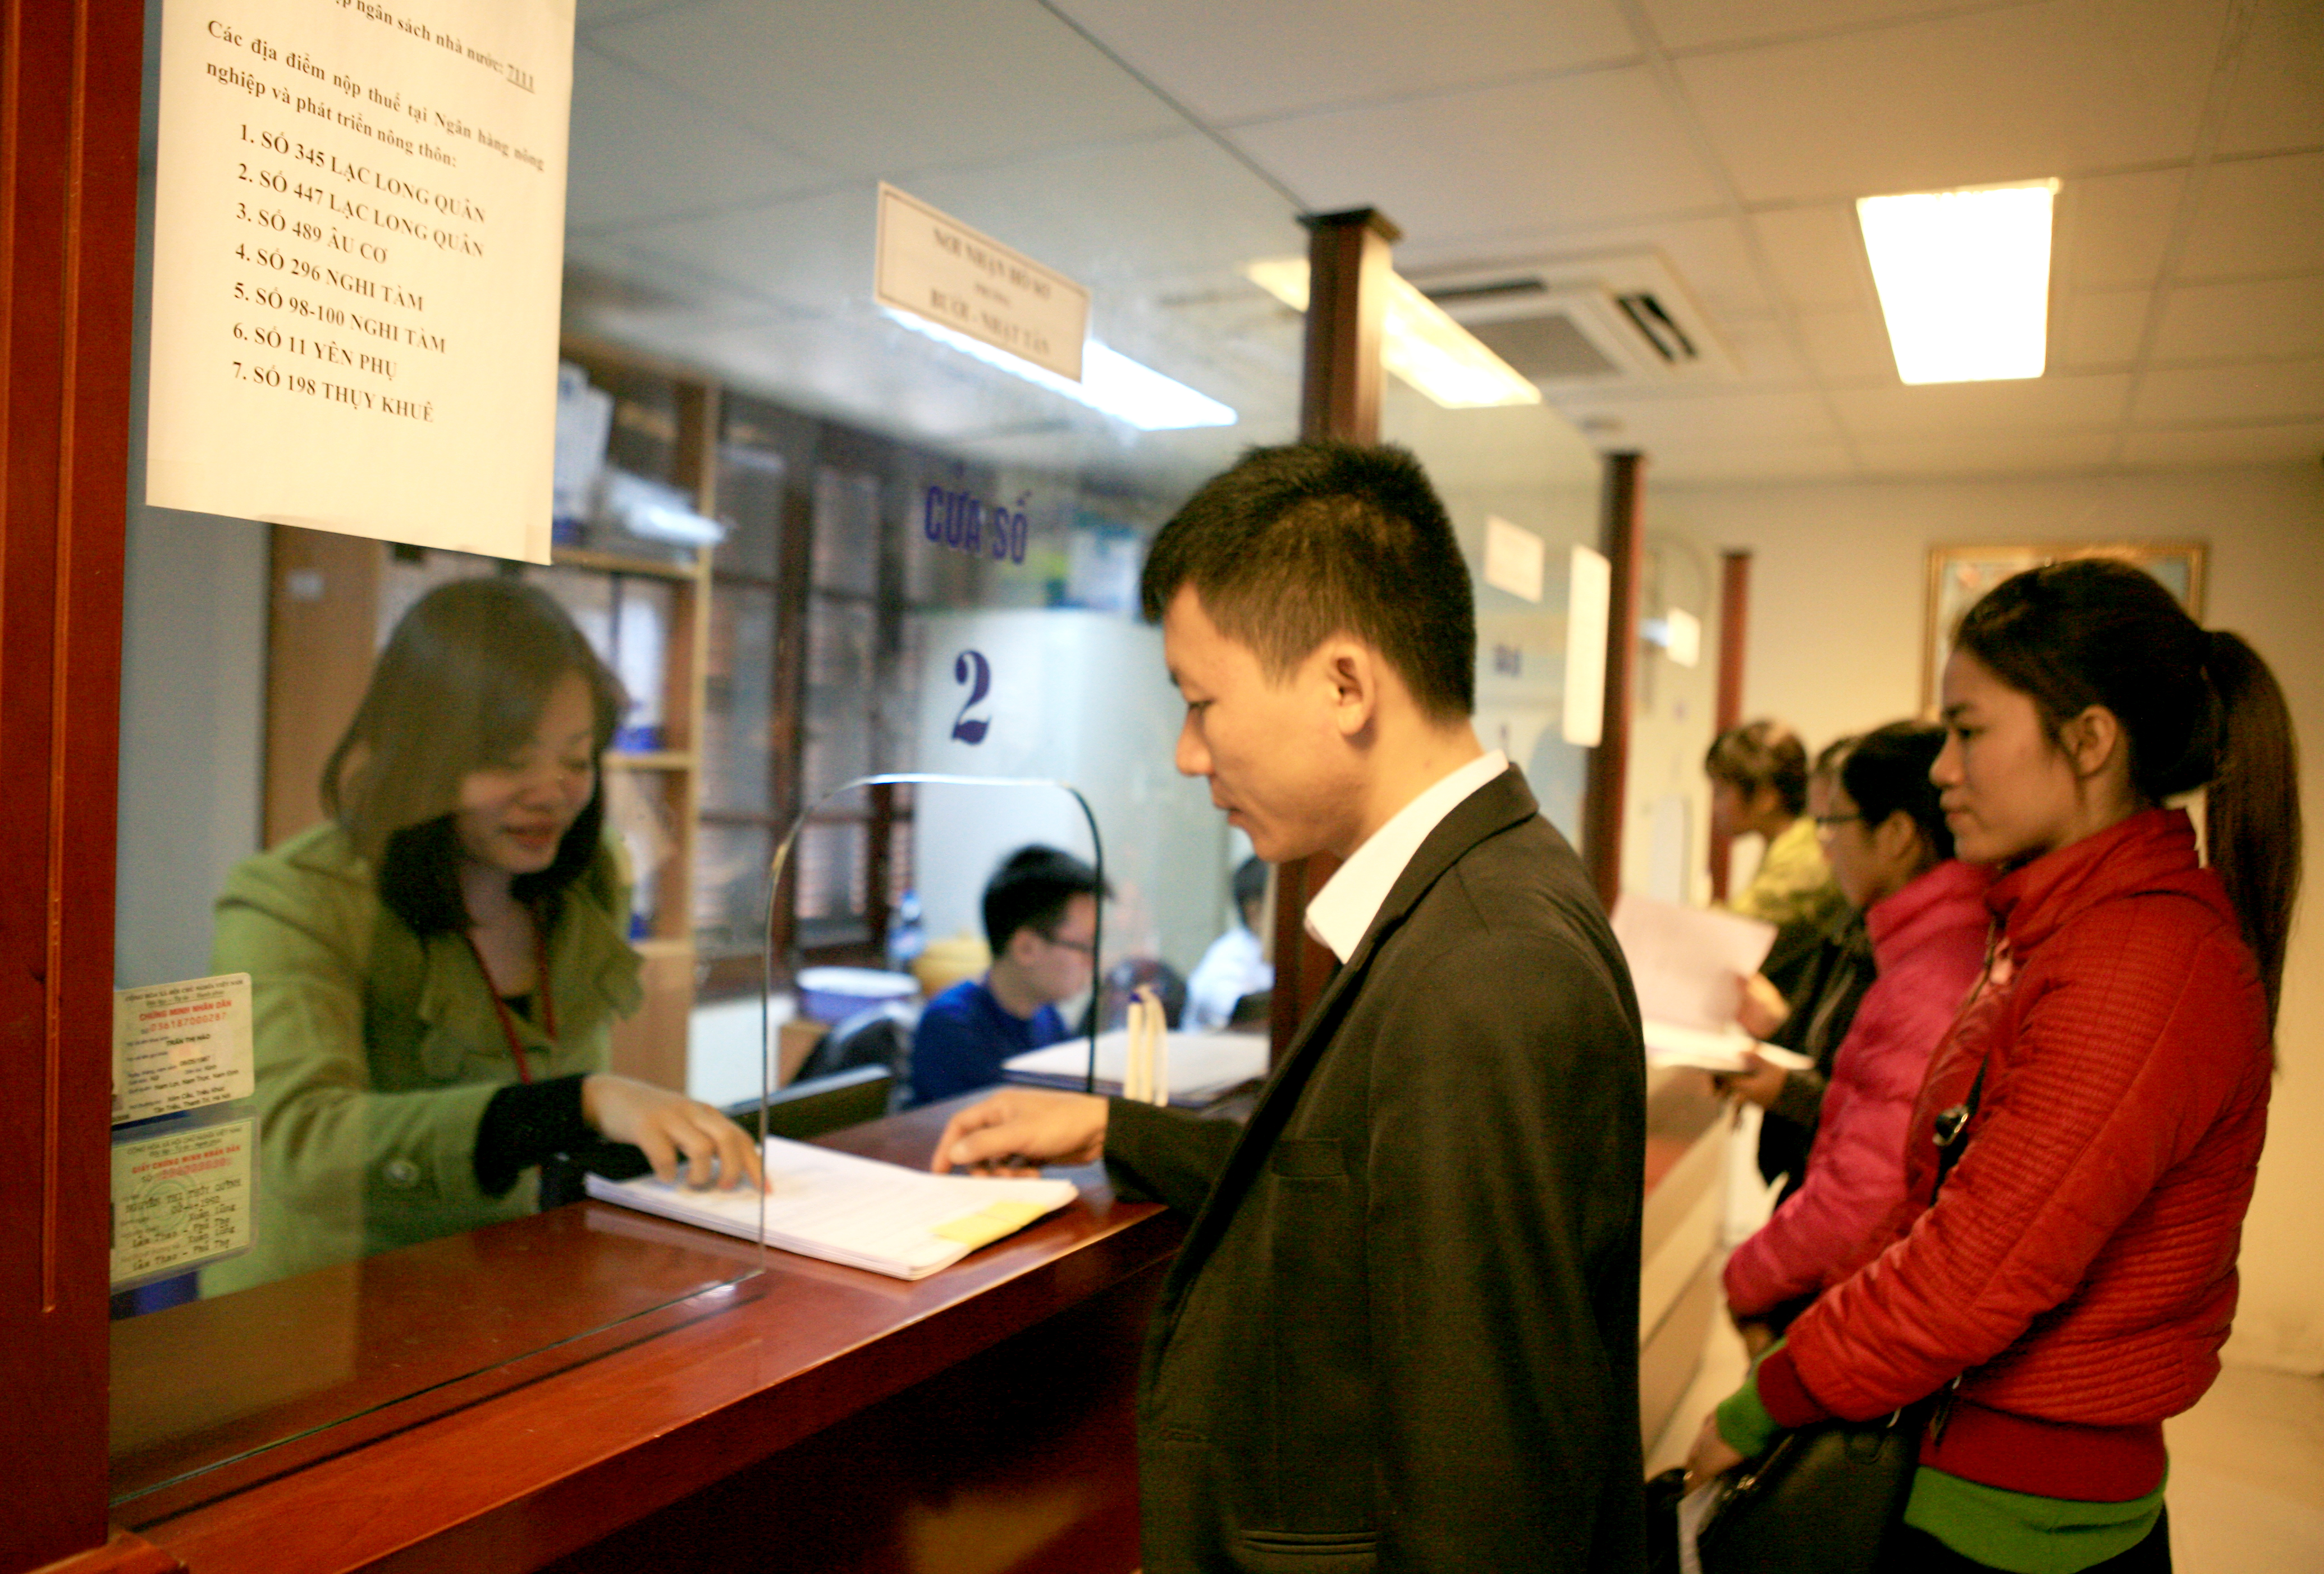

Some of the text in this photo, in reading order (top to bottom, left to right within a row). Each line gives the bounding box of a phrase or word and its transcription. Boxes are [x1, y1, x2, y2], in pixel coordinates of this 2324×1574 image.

[357, 0, 535, 93] ngân sách nhà nước: 7111
[206, 62, 457, 168] nghiệp và phát triển nông thôn:
[207, 20, 545, 172] Các địa điểm nộp thuế tại Ngân hàng nông
[237, 162, 484, 259] 2. SỐ 447 LẠC LONG QUÂN
[240, 123, 486, 225] 1. SỐ 345 LẠC LONG QUÂN
[236, 202, 388, 265] 3. SỐ 489 ÂU CƠ
[233, 281, 447, 354] 5. SỐ 98-100 NGHI TÀM
[235, 243, 424, 313] 4. SỐ 296 NGHI TÀM
[231, 360, 434, 423] 7. SỐ 198 THỤY KHUÊ
[232, 322, 397, 379] 6. SỐ 11 YÊN PHỤ
[991, 489, 1033, 565] SỐ
[951, 649, 992, 745] 2
